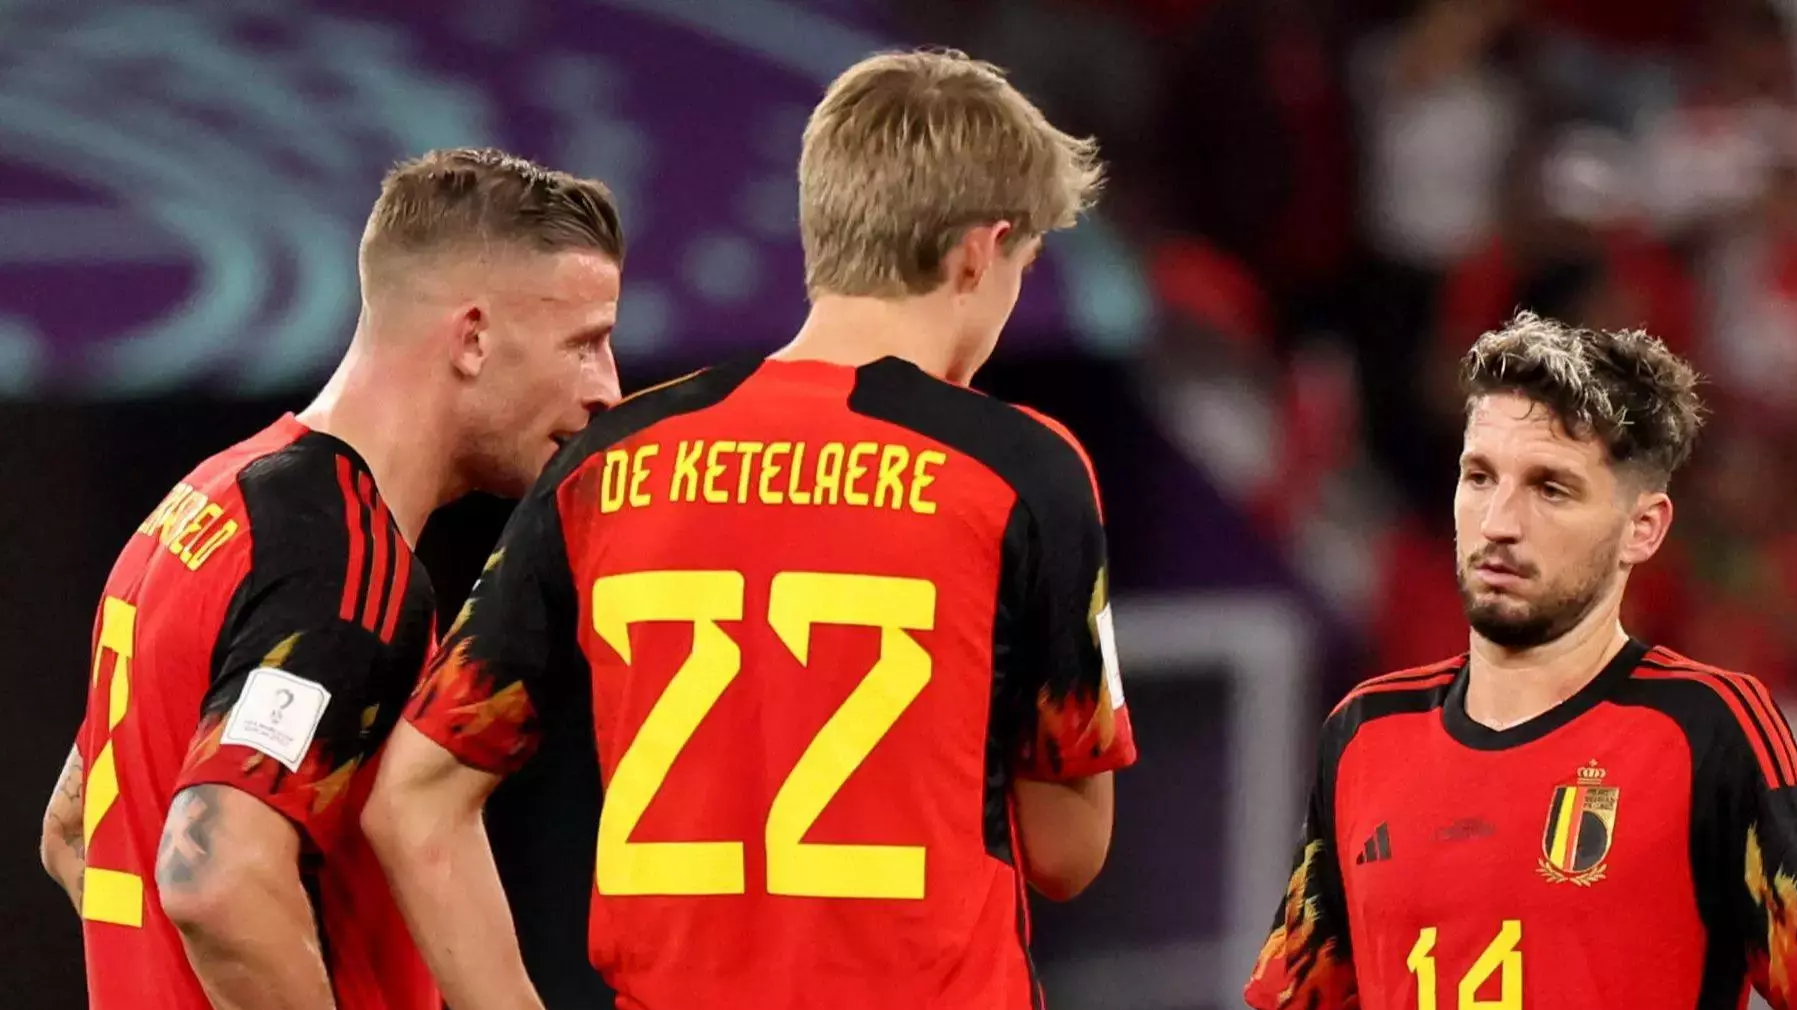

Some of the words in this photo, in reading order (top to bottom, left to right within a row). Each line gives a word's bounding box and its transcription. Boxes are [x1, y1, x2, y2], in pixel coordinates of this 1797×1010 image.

[600, 444, 660, 515] DE
[668, 440, 947, 515] KETELAERE
[82, 595, 143, 928] 2
[592, 570, 936, 899] 22
